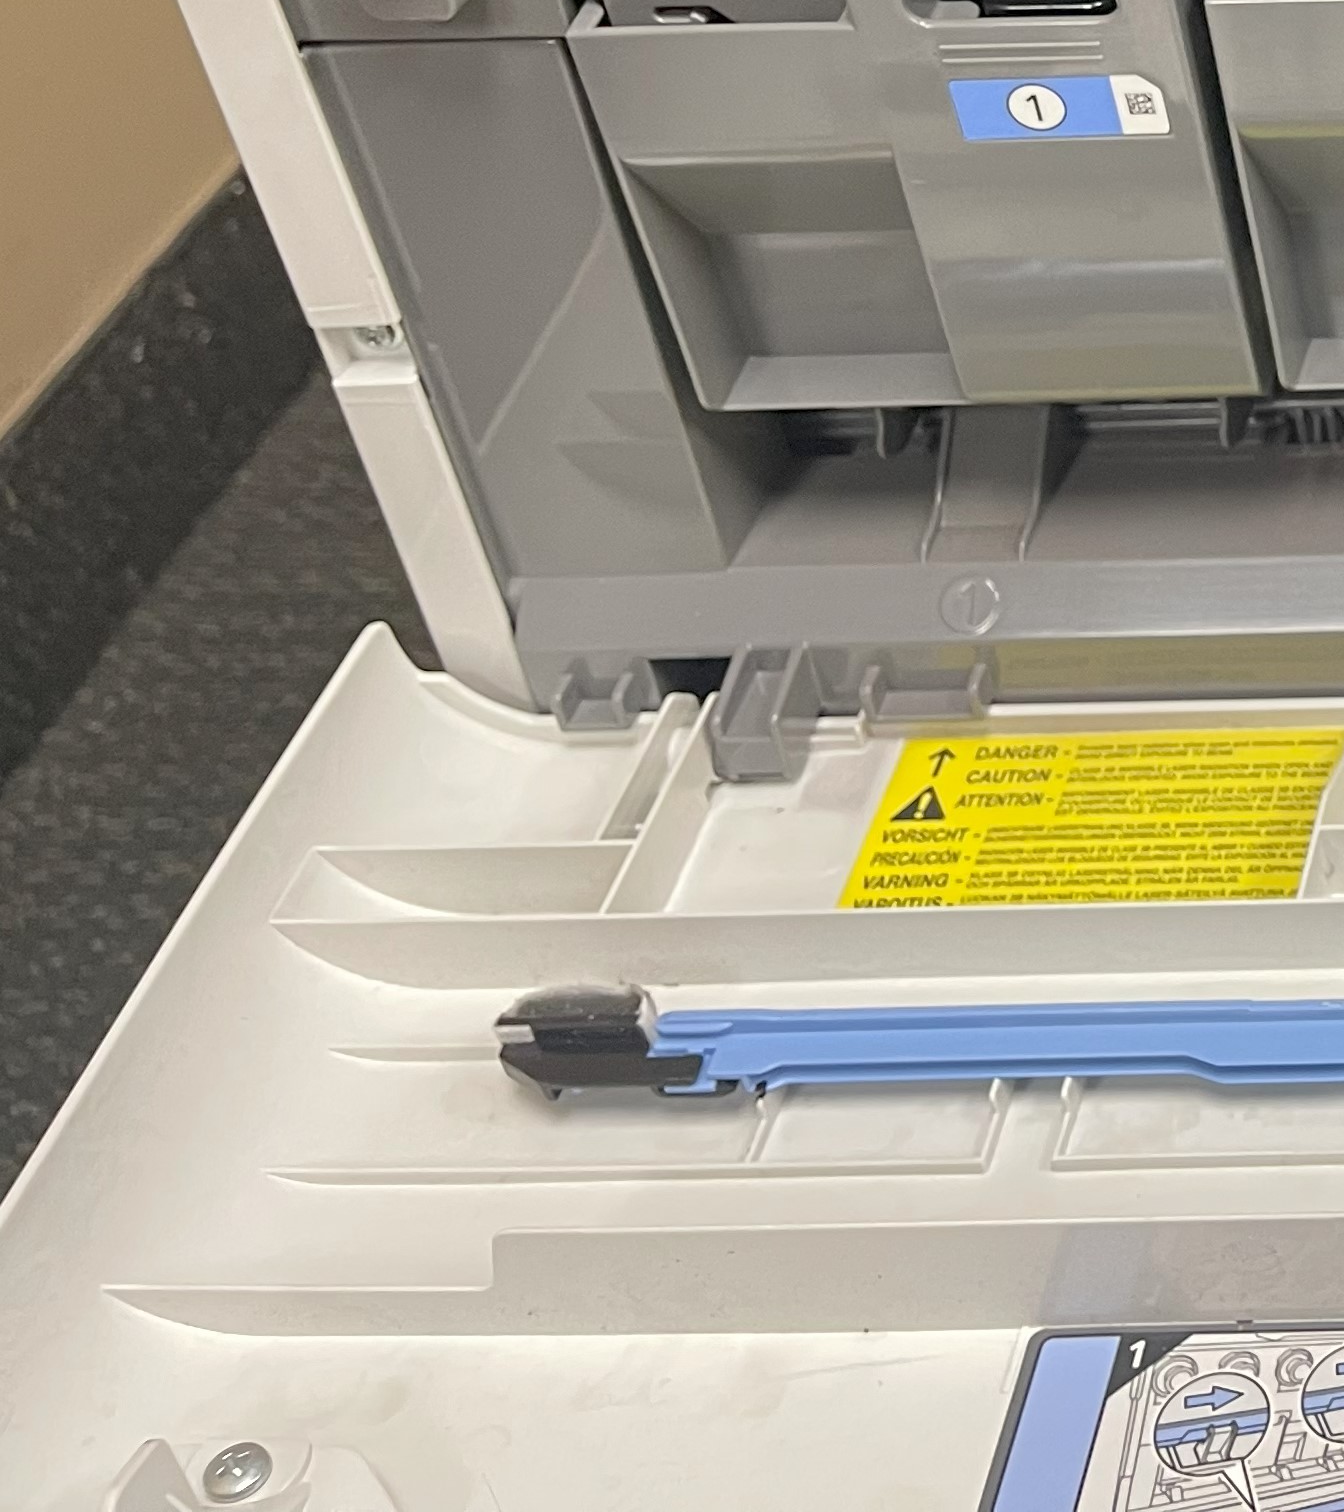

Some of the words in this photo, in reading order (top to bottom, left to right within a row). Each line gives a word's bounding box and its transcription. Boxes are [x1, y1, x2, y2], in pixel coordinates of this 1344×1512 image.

[975, 745, 1058, 760] DANGER
[966, 768, 1053, 784] CAUTION
[955, 791, 1044, 808] ATTENTION
[882, 827, 970, 843] VORSICHT
[863, 873, 949, 889] VARNING
[1130, 1340, 1147, 1368] 1
